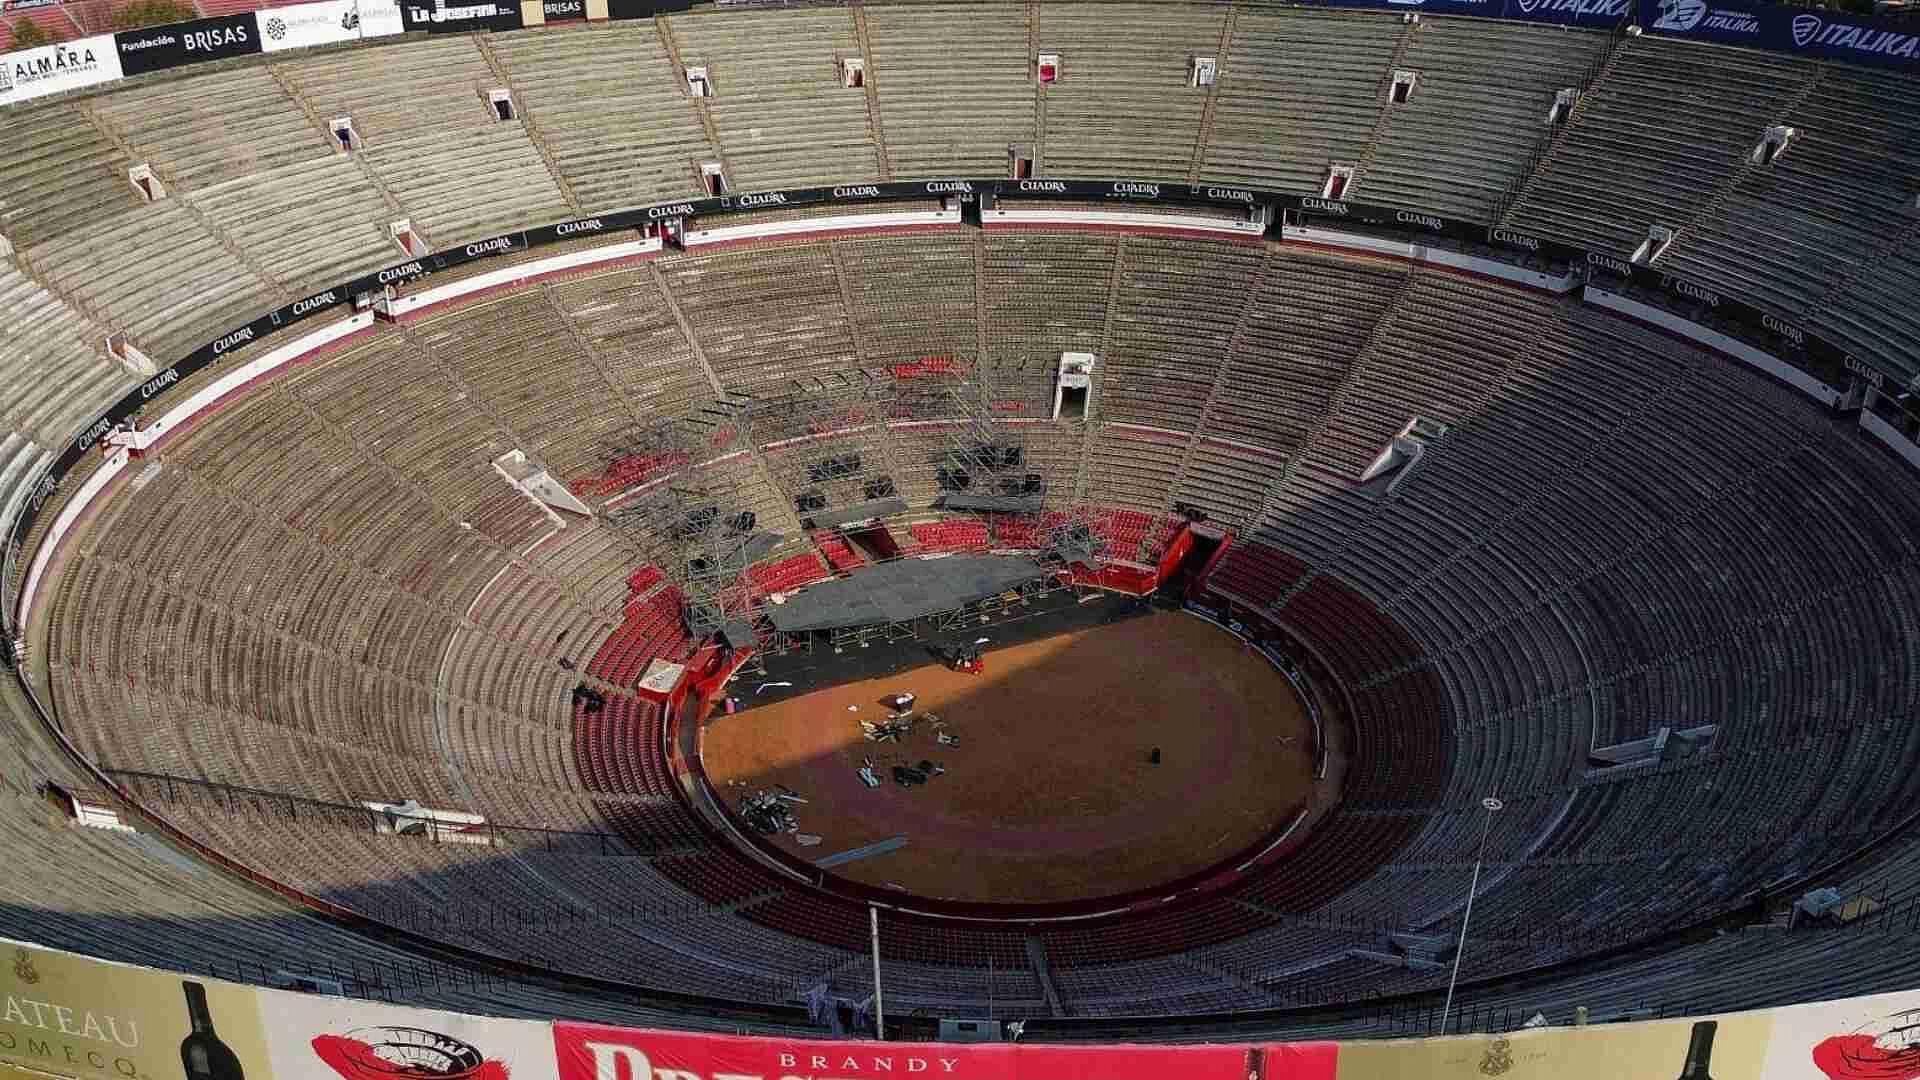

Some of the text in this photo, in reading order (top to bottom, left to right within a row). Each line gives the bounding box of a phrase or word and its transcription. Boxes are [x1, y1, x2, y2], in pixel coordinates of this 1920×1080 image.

[544, 1, 581, 15] BRISAS
[183, 26, 247, 51] BRISAS
[1816, 24, 1918, 58] ITALIKA
[833, 185, 880, 198] CUADRA
[927, 181, 973, 193] CUADRA
[1020, 180, 1067, 193] CUADRA
[740, 191, 787, 206] CUADRA
[1302, 197, 1349, 214] CUADRA
[648, 203, 694, 219] CUADRA
[1396, 211, 1443, 230] CUADRA
[556, 218, 603, 235] CUADRA
[466, 237, 512, 257] CUADRA
[1494, 229, 1540, 250] CUADRA
[378, 262, 423, 283] CUADRA
[1586, 252, 1632, 277] CUADRA
[292, 291, 336, 316] CUADRA
[213, 326, 254, 354] CUADRA
[780, 1053, 959, 1072] BRANDY
